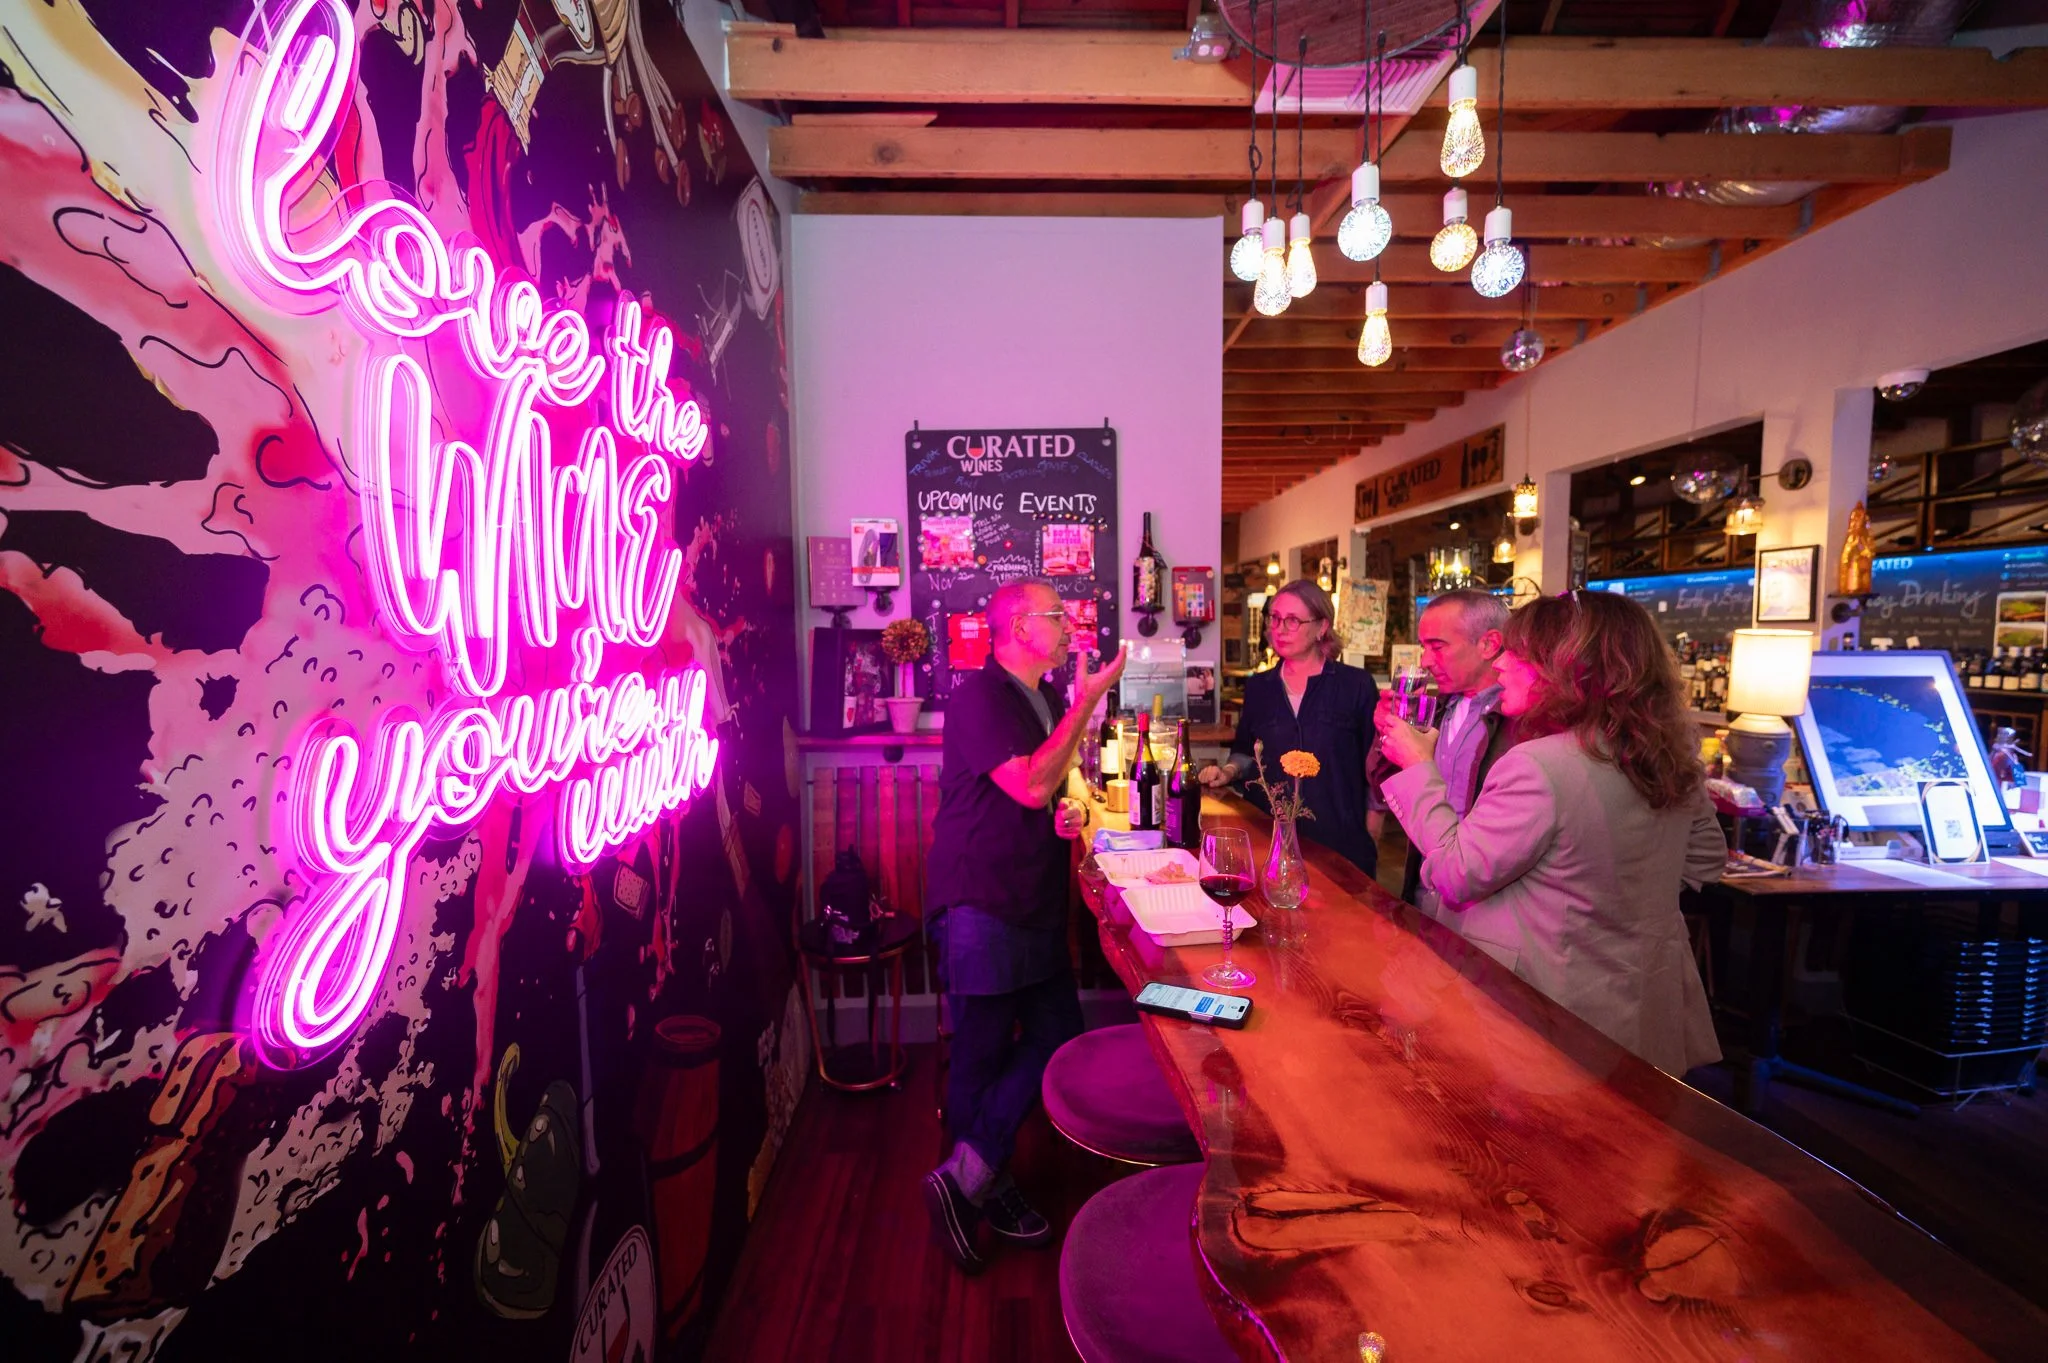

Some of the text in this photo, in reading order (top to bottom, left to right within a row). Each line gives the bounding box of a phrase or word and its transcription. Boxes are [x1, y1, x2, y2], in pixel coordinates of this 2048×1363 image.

[946, 434, 1076, 459] CURATED
[960, 459, 1004, 473] WINES
[1383, 457, 1441, 497] CURATED
[918, 490, 1098, 515] UPCOMING EVENTS
[928, 573, 956, 591] Nov
[580, 1241, 638, 1355] CURATED
